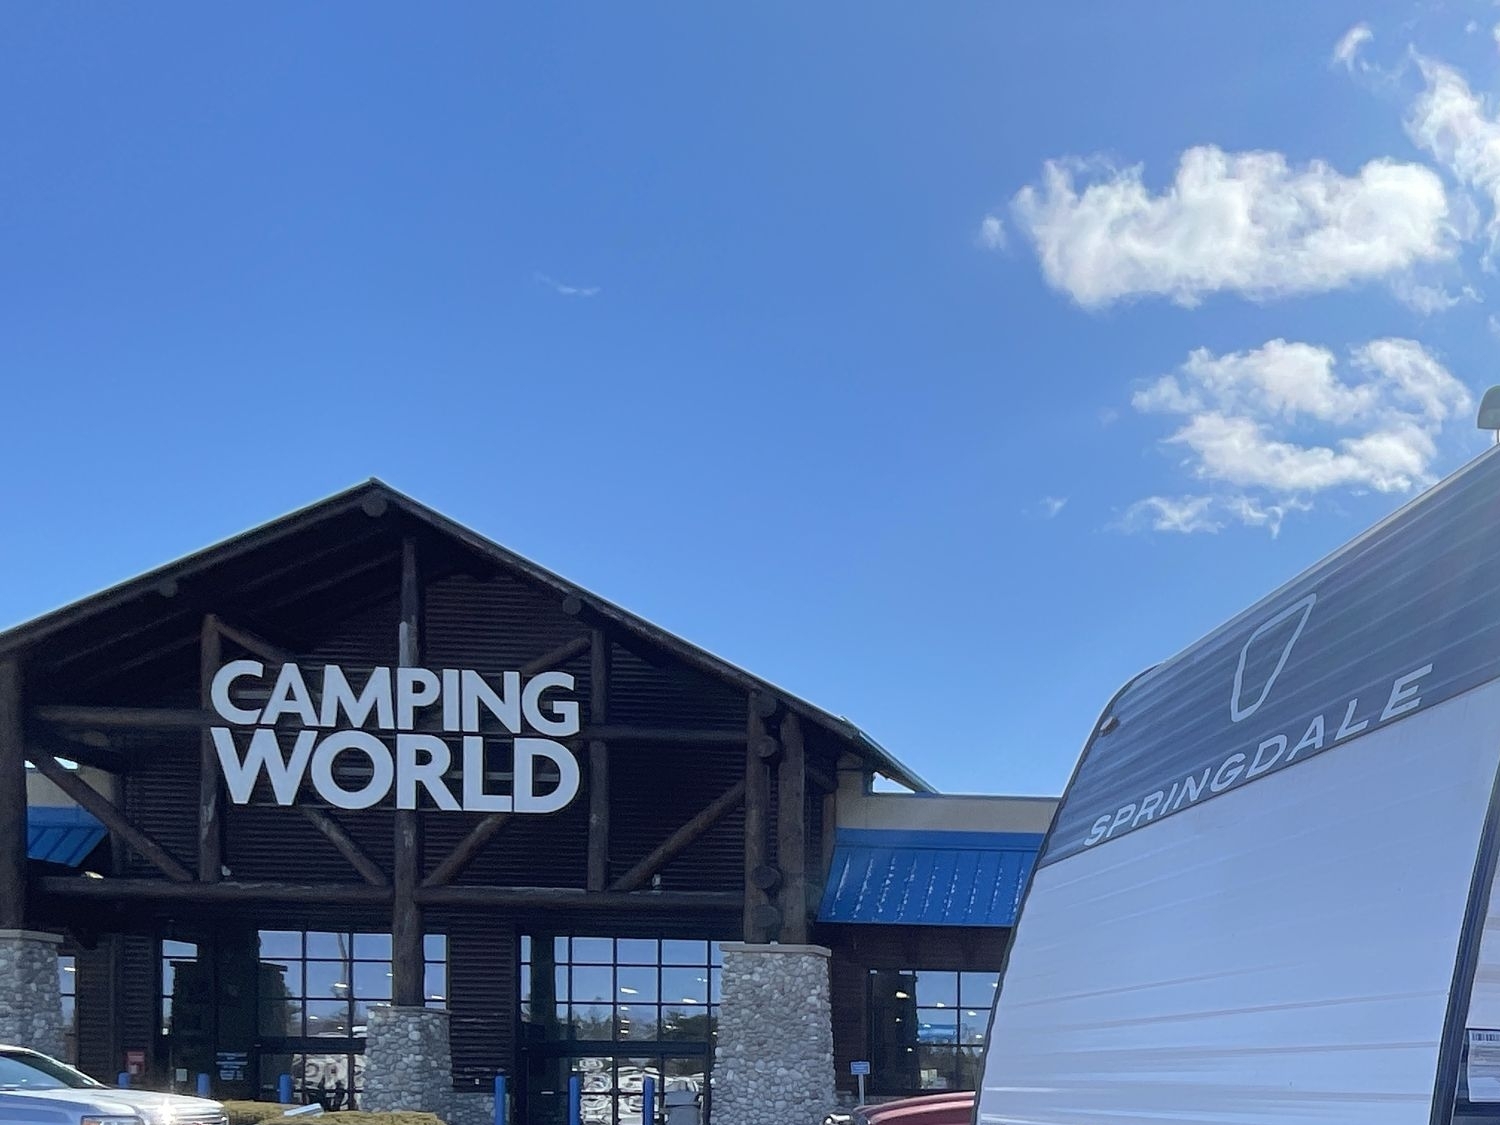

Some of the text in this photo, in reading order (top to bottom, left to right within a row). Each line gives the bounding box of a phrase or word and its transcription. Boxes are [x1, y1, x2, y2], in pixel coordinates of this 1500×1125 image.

[210, 660, 580, 737] CAMPING
[210, 727, 580, 813] WORLD
[1083, 663, 1433, 846] SPRINGDALE
